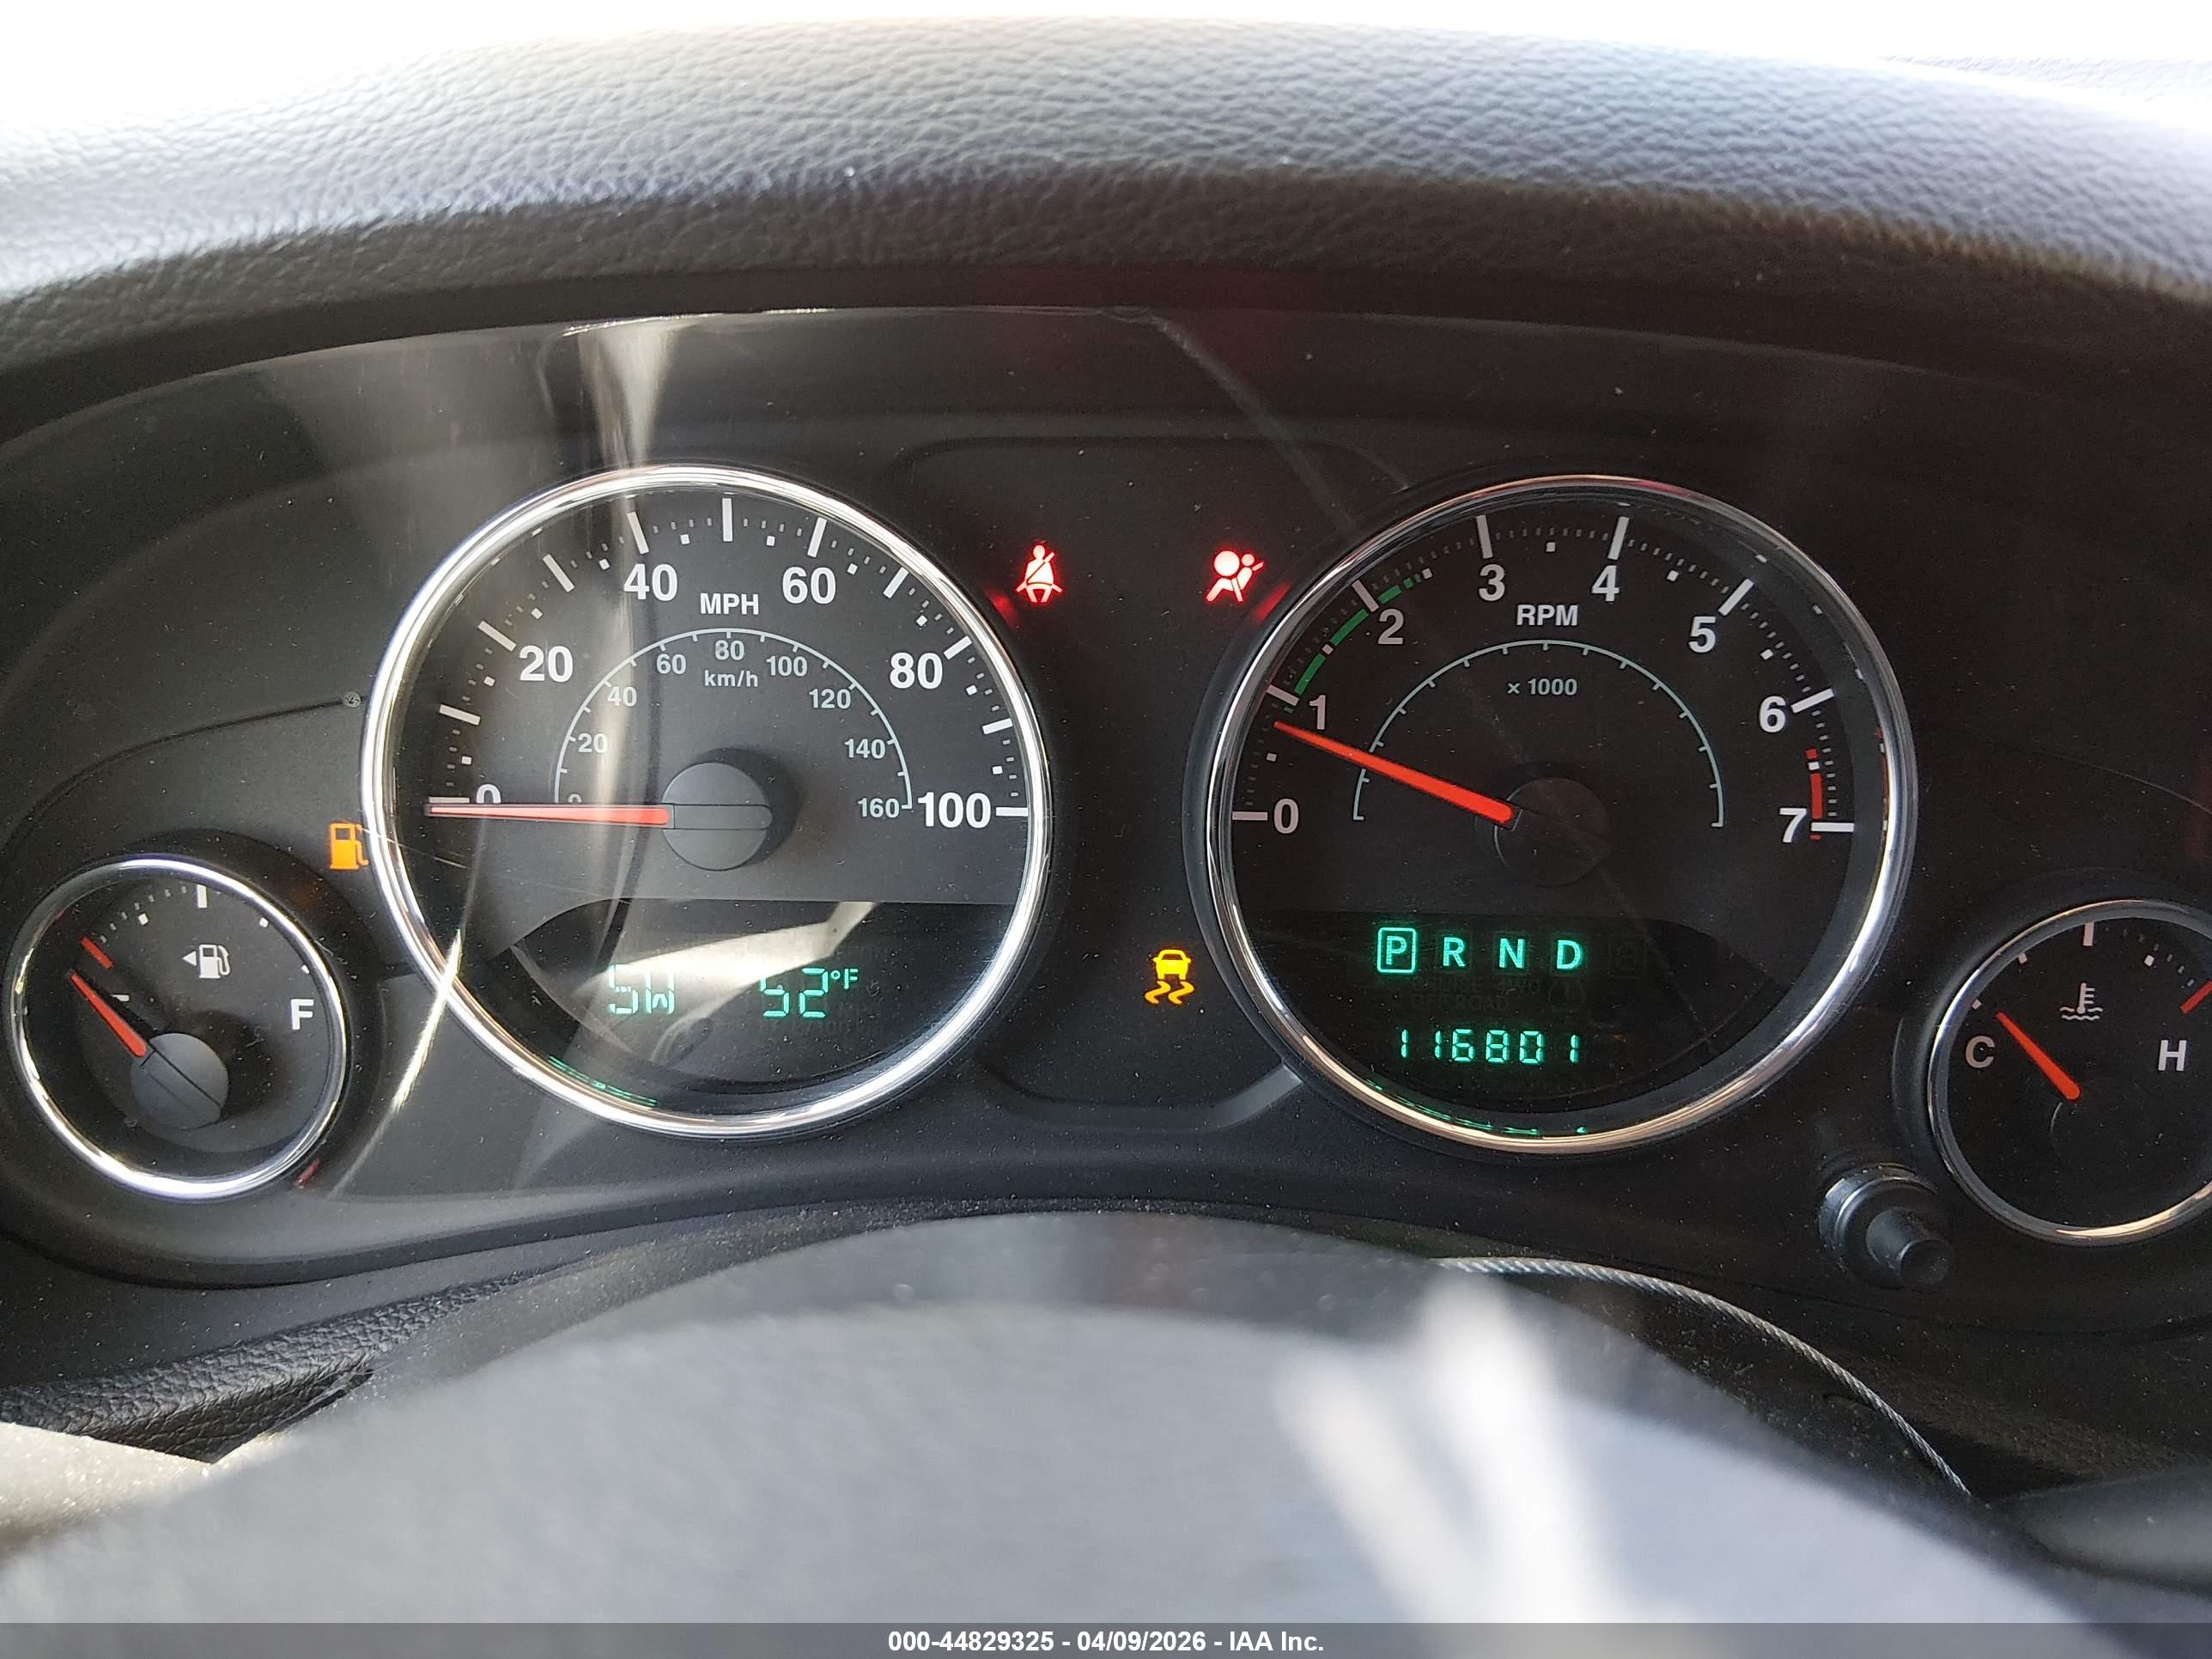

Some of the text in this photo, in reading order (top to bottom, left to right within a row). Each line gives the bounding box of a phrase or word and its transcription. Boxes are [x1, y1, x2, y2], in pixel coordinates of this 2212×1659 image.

[624, 563, 678, 601] 40
[782, 566, 836, 605] 60
[1479, 563, 1505, 601] 3
[1591, 565, 1620, 602] 4
[700, 592, 759, 616] MPH
[1516, 604, 1578, 626] RPM
[1377, 609, 1405, 645] 2
[1688, 616, 1717, 653] 5
[519, 645, 574, 683] 20
[656, 653, 687, 675] 60
[714, 639, 745, 661] 80
[766, 655, 808, 677] 100
[704, 668, 758, 689] km/h
[890, 650, 943, 690] 80
[1528, 678, 1577, 696] 1000
[605, 685, 638, 708] 40
[809, 688, 851, 709] 120
[1310, 694, 1326, 730] 1
[1759, 696, 1786, 733] 6
[578, 732, 608, 754] 20
[844, 738, 886, 759] 140
[857, 798, 900, 818] 160
[917, 792, 991, 829] 100
[1273, 798, 1299, 834] 0
[1779, 807, 1808, 843] 7
[1385, 935, 1583, 970] P R N D
[290, 998, 314, 1030] F
[1400, 1028, 1580, 1065] 116801
[1965, 1036, 1996, 1068] C
[2157, 1039, 2187, 1072] H
